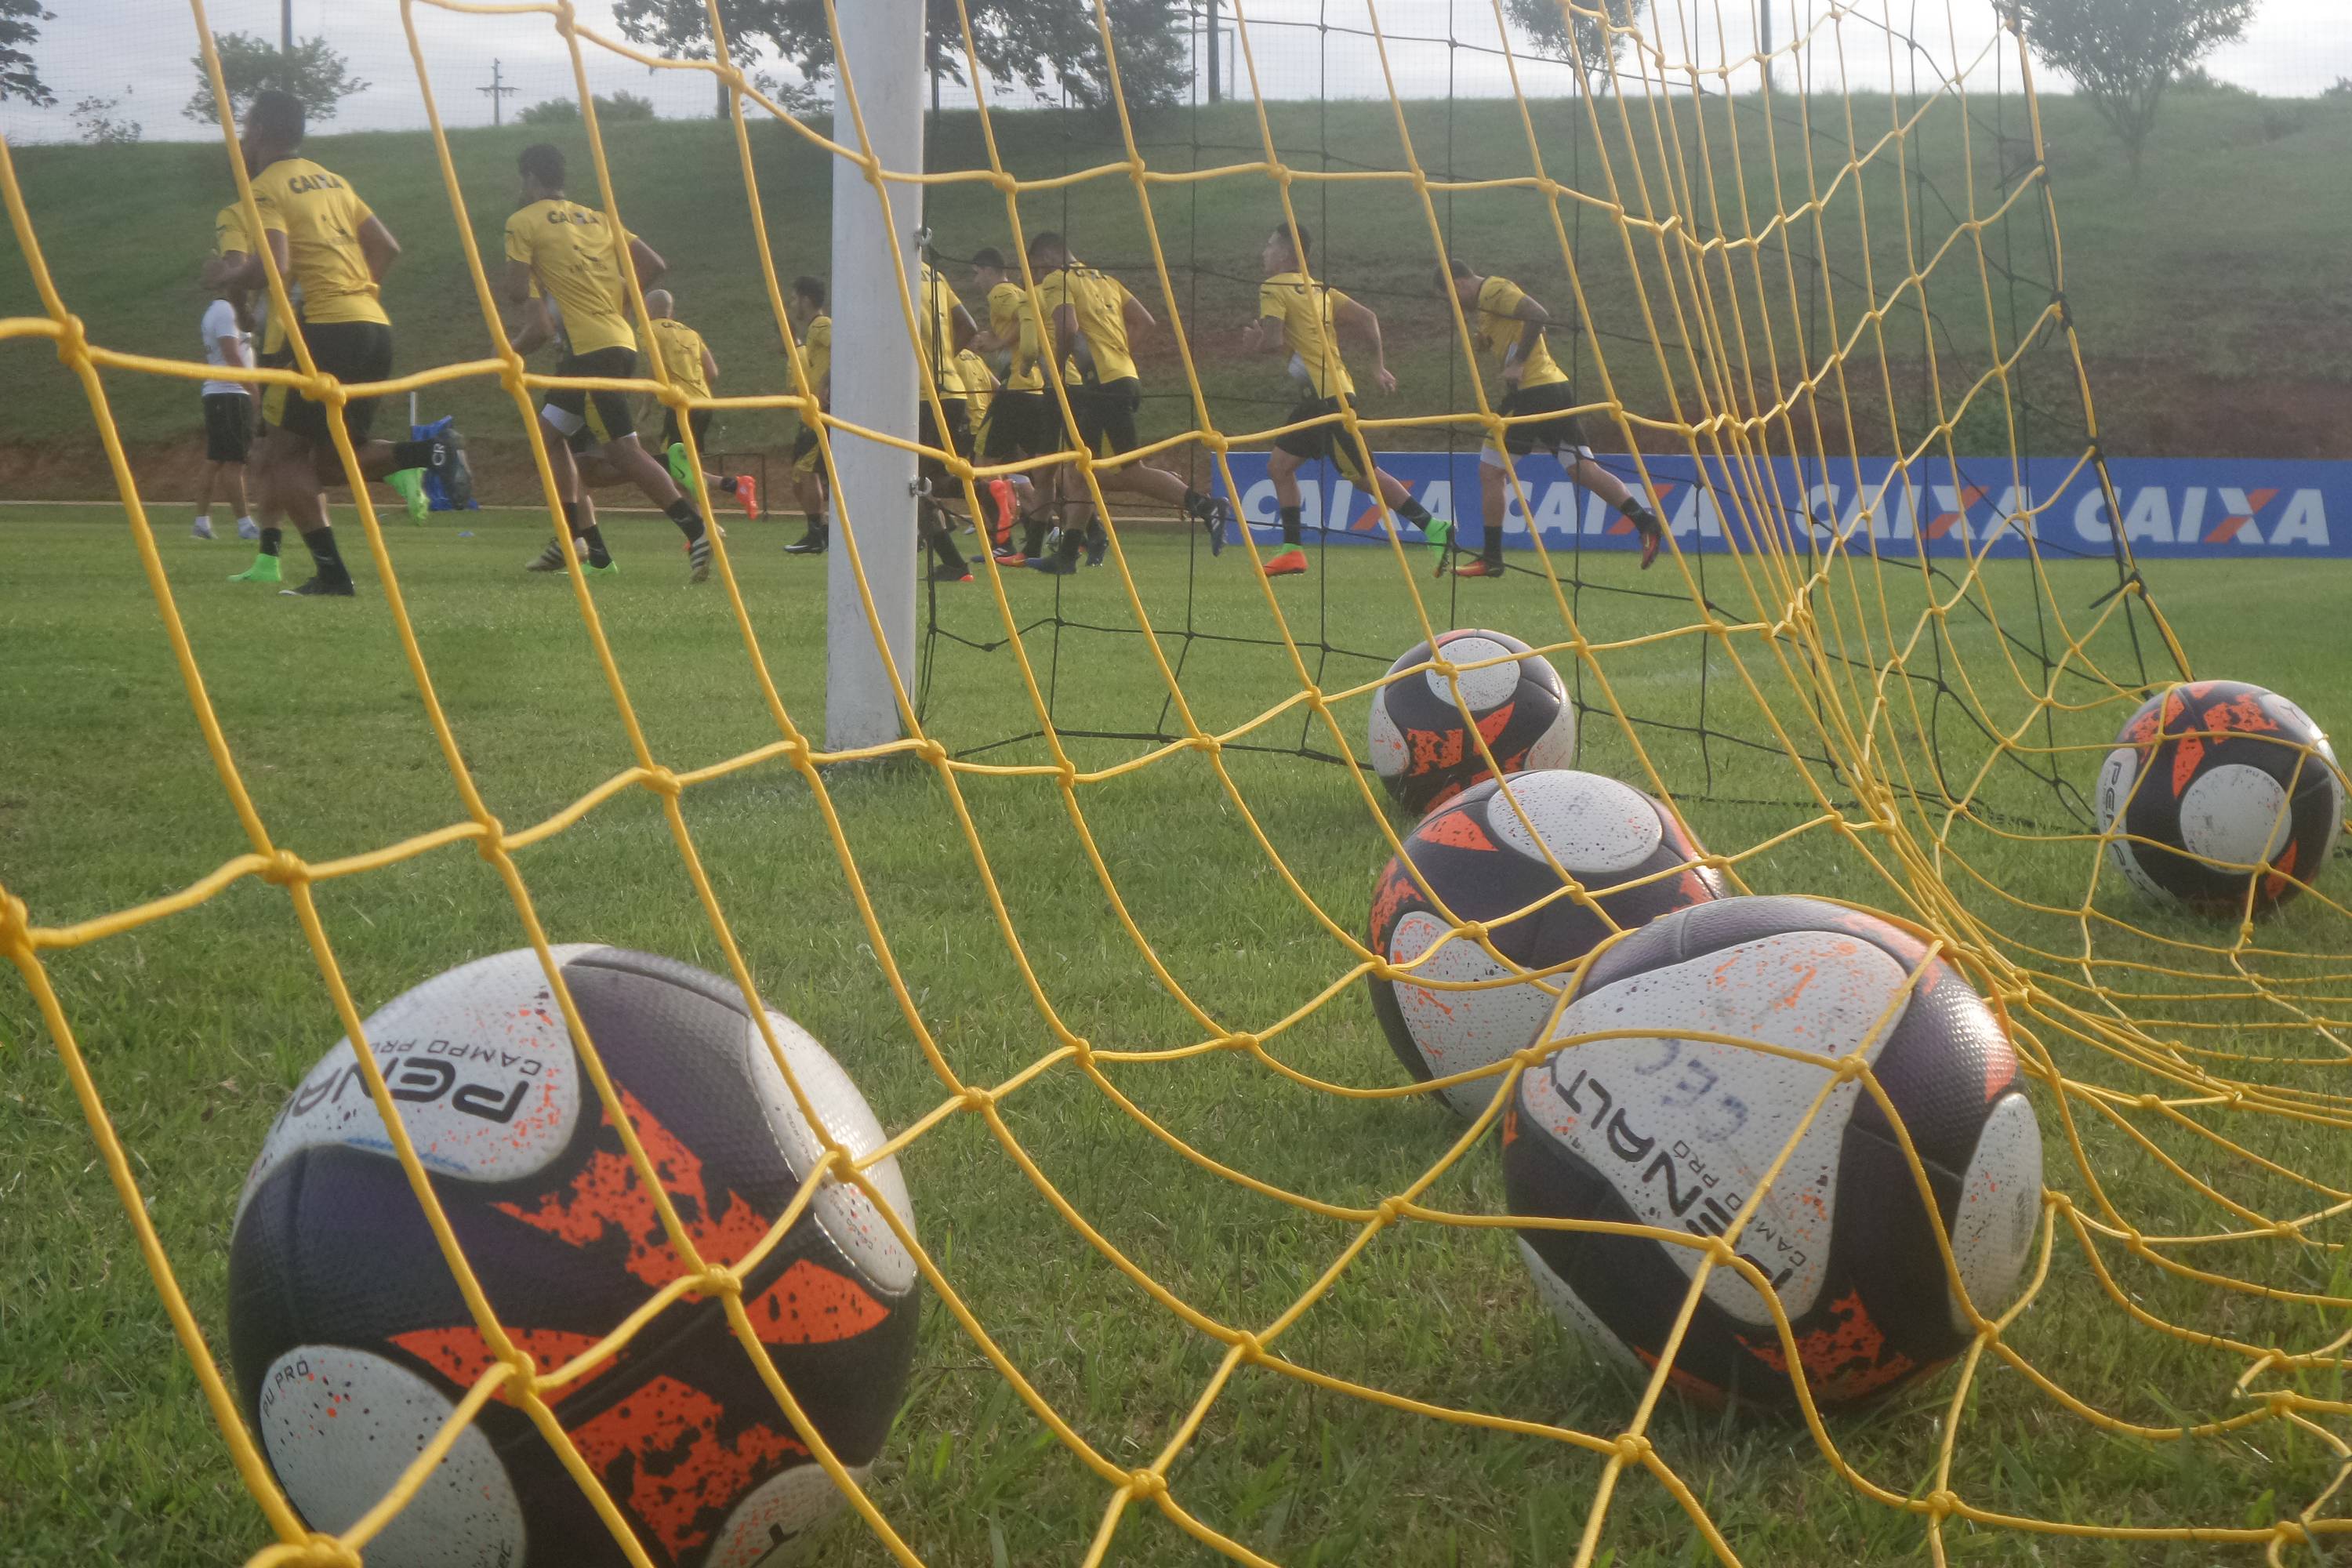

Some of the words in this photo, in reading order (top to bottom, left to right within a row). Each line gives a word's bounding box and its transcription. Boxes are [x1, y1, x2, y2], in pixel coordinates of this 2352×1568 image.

[1795, 484, 2038, 541] CAIXA
[2074, 486, 2329, 546] CAIXA
[427, 1040, 542, 1076] CAMPO
[1726, 1192, 1806, 1267] CAMO
